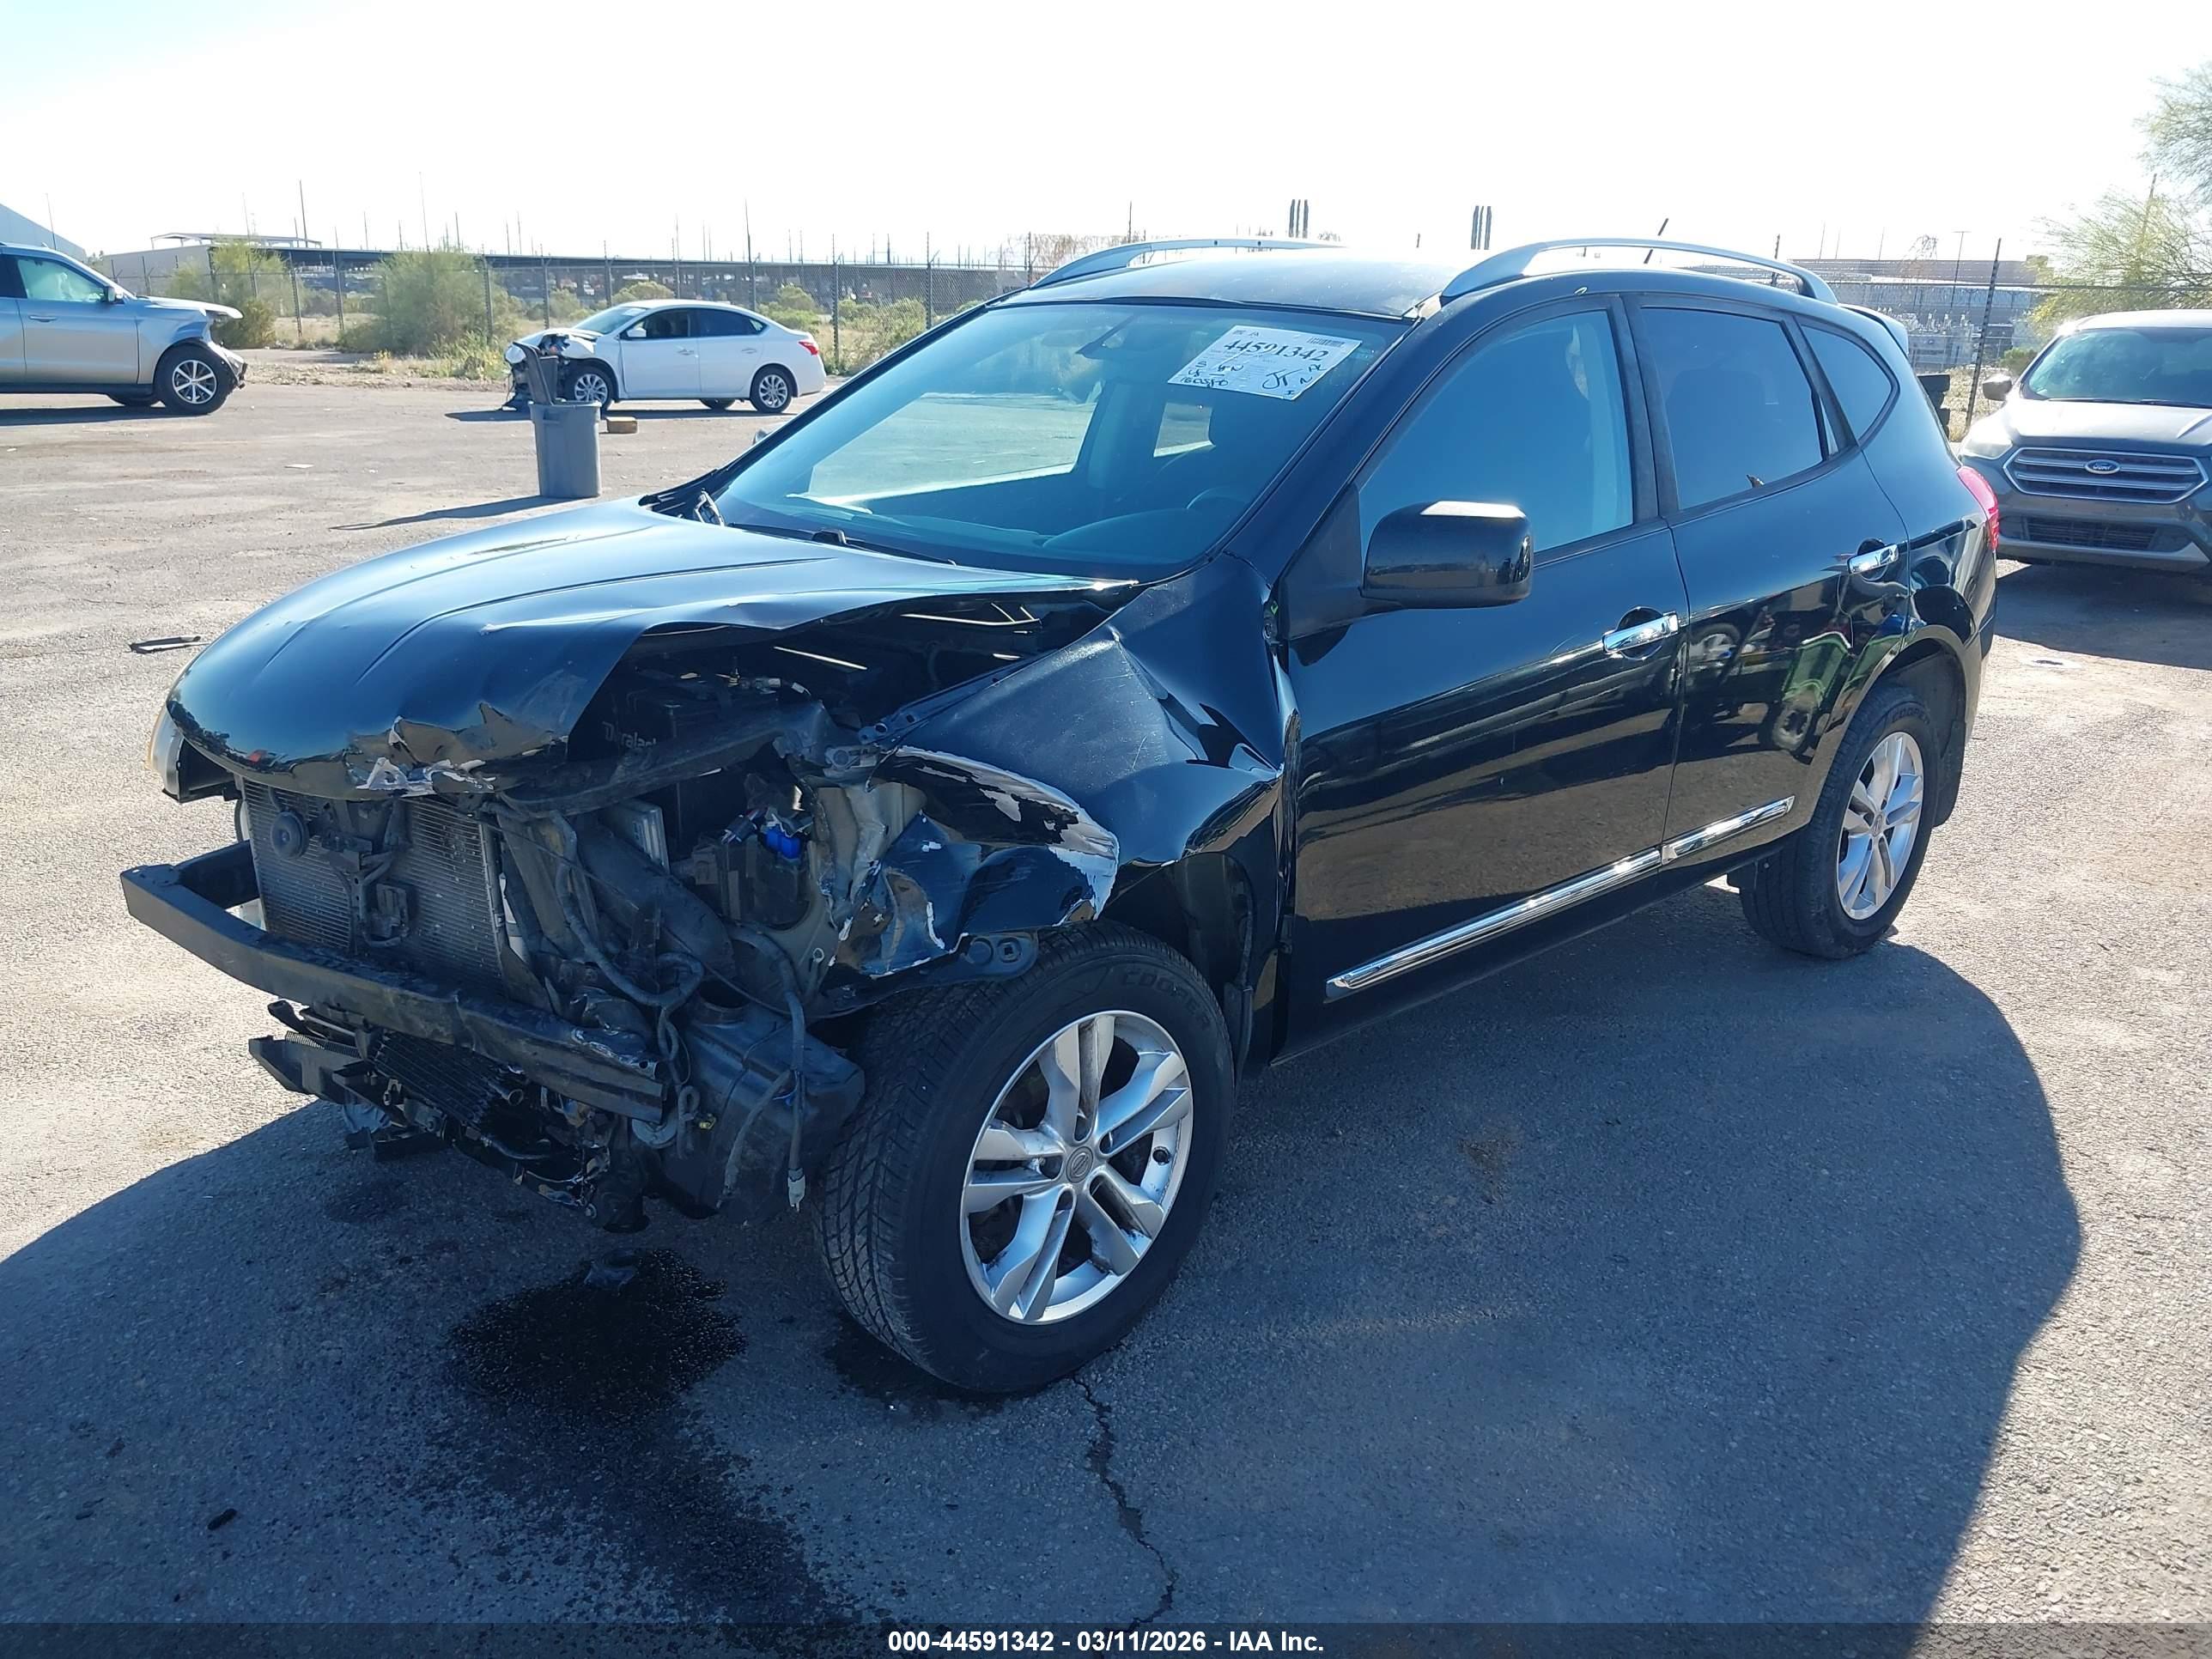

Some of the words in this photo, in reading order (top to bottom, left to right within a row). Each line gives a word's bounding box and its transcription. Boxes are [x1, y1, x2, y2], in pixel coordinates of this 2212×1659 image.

[1224, 338, 1329, 362] 44591342
[2091, 461, 2113, 471] Ford
[1892, 708, 1930, 726] COOPER
[1122, 971, 1212, 1031] COOPER
